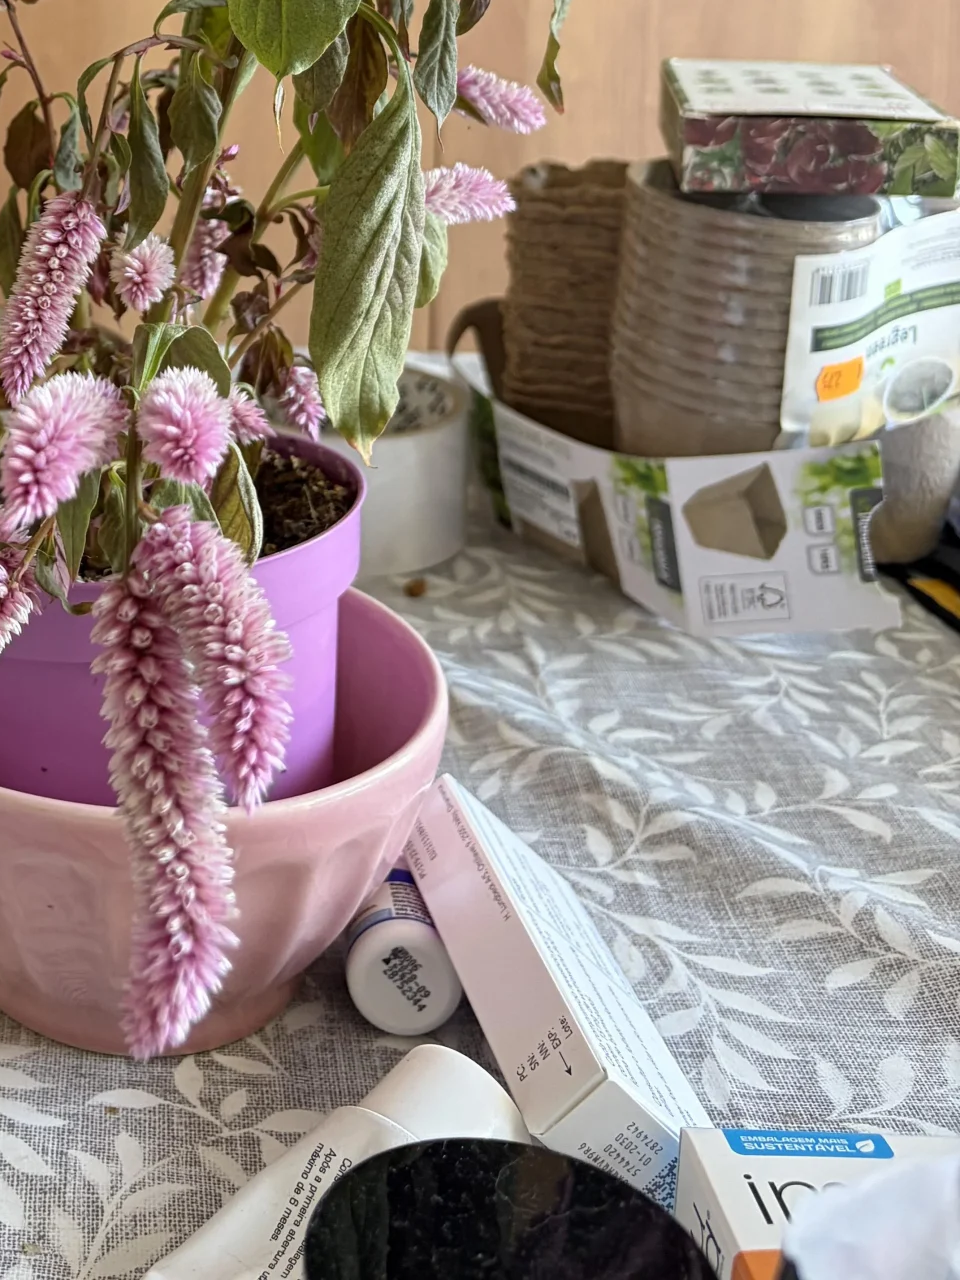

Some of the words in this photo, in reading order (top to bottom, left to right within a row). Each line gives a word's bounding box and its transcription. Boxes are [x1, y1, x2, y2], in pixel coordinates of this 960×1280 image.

[547, 1027, 562, 1050] EXP:
[558, 1015, 574, 1040] Lote:
[526, 1052, 540, 1071] SN:
[537, 1039, 551, 1061] NN:
[516, 1063, 529, 1082] PC:
[615, 1133, 652, 1166] 01-2030
[627, 1122, 663, 1155] 2874942
[740, 1135, 816, 1145] EMBALAGEM
[818, 1137, 848, 1146] MAIS
[743, 1142, 857, 1154] SUSTENTÁVEL
[300, 1142, 325, 1180] máximo
[318, 1147, 337, 1175] Após
[604, 1144, 641, 1176] 5744420
[295, 1181, 307, 1196] de
[313, 1175, 322, 1184] a
[288, 1196, 300, 1208] 6
[292, 1183, 318, 1228] primeira
[269, 1207, 293, 1242] meses.
[267, 1228, 296, 1270] abertura
